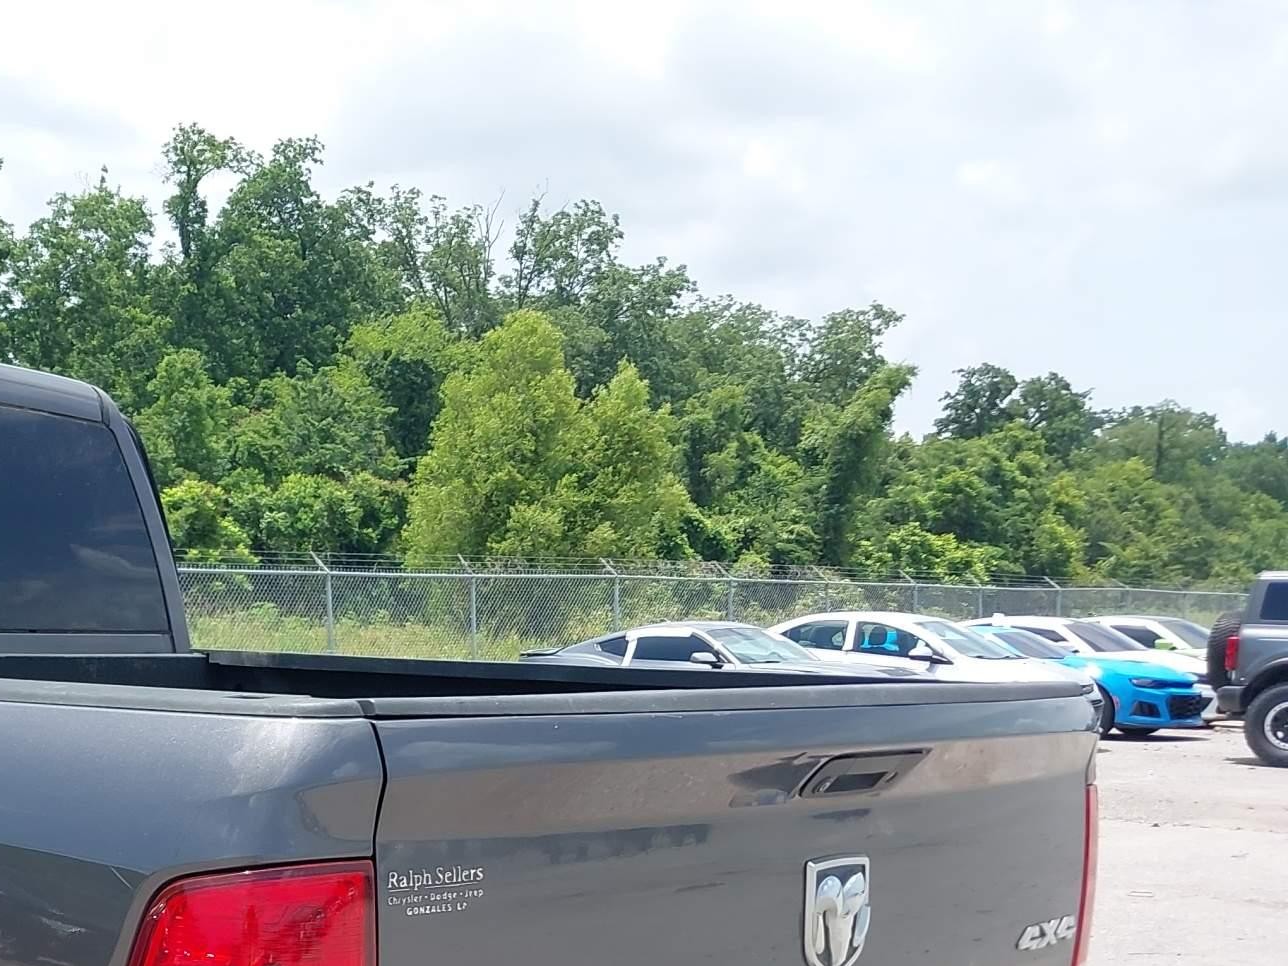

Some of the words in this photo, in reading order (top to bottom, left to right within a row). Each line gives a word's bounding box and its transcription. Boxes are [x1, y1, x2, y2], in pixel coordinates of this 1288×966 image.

[387, 868, 432, 891] Ralph
[434, 865, 484, 885] Sellers
[430, 891, 458, 902] Dodge
[406, 903, 453, 916] GONZALES
